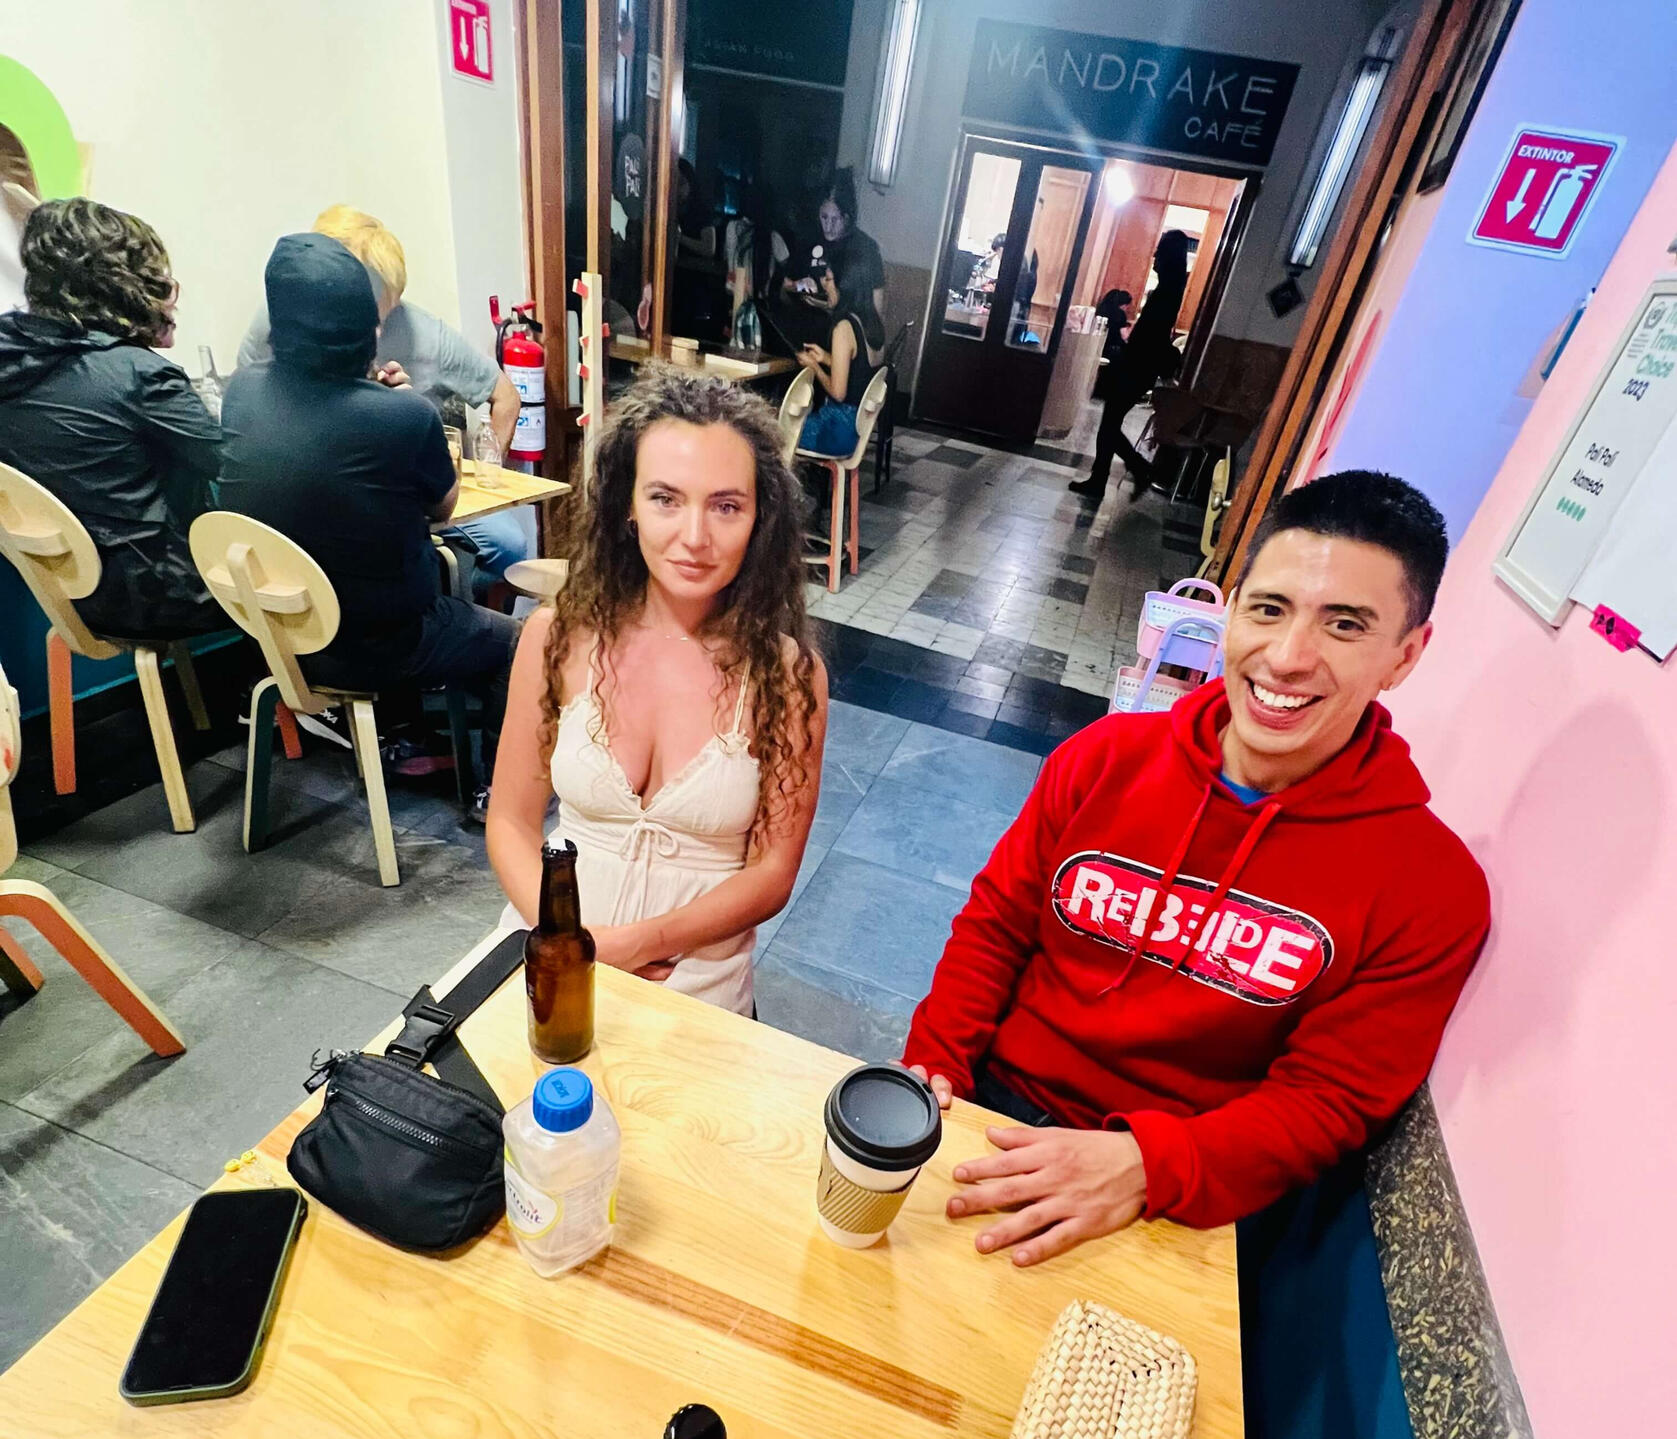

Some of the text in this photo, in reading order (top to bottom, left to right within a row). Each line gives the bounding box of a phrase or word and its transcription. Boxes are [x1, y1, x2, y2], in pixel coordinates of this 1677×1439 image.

[987, 40, 1278, 115] MANDRAKE
[1518, 145, 1575, 164] EXTINTOR
[1622, 378, 1650, 401] 2023
